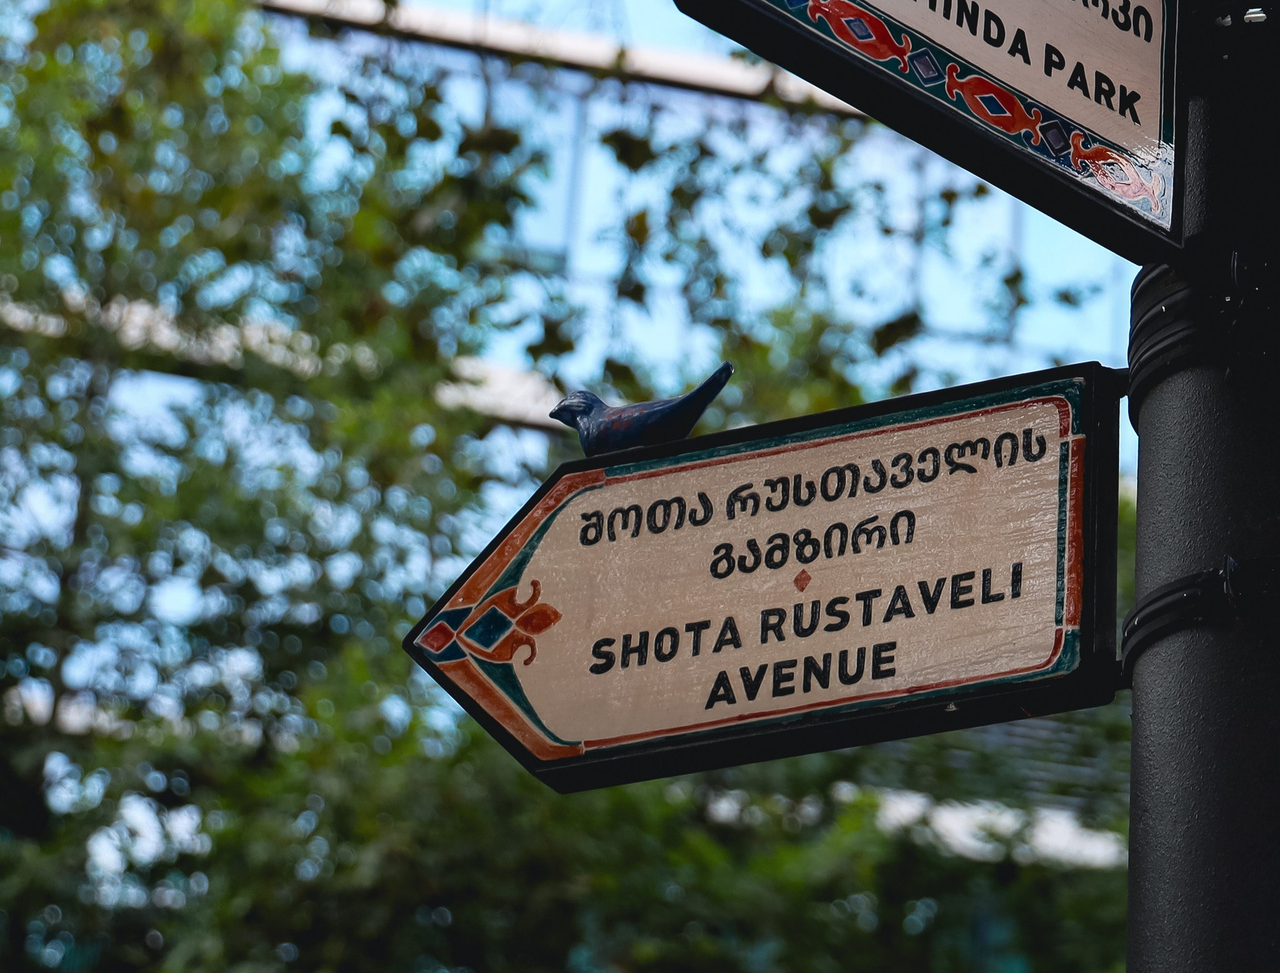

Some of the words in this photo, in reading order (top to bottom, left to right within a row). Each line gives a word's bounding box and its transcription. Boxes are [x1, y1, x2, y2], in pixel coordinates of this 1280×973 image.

[1042, 43, 1142, 127] PARK
[579, 492, 714, 547] შოთა
[725, 427, 1047, 521] რუსთაველის
[709, 510, 917, 579] გამზირი
[589, 616, 742, 675] SHOTA
[760, 562, 1024, 645] RUSTAVELI
[705, 640, 898, 710] AVENUE
